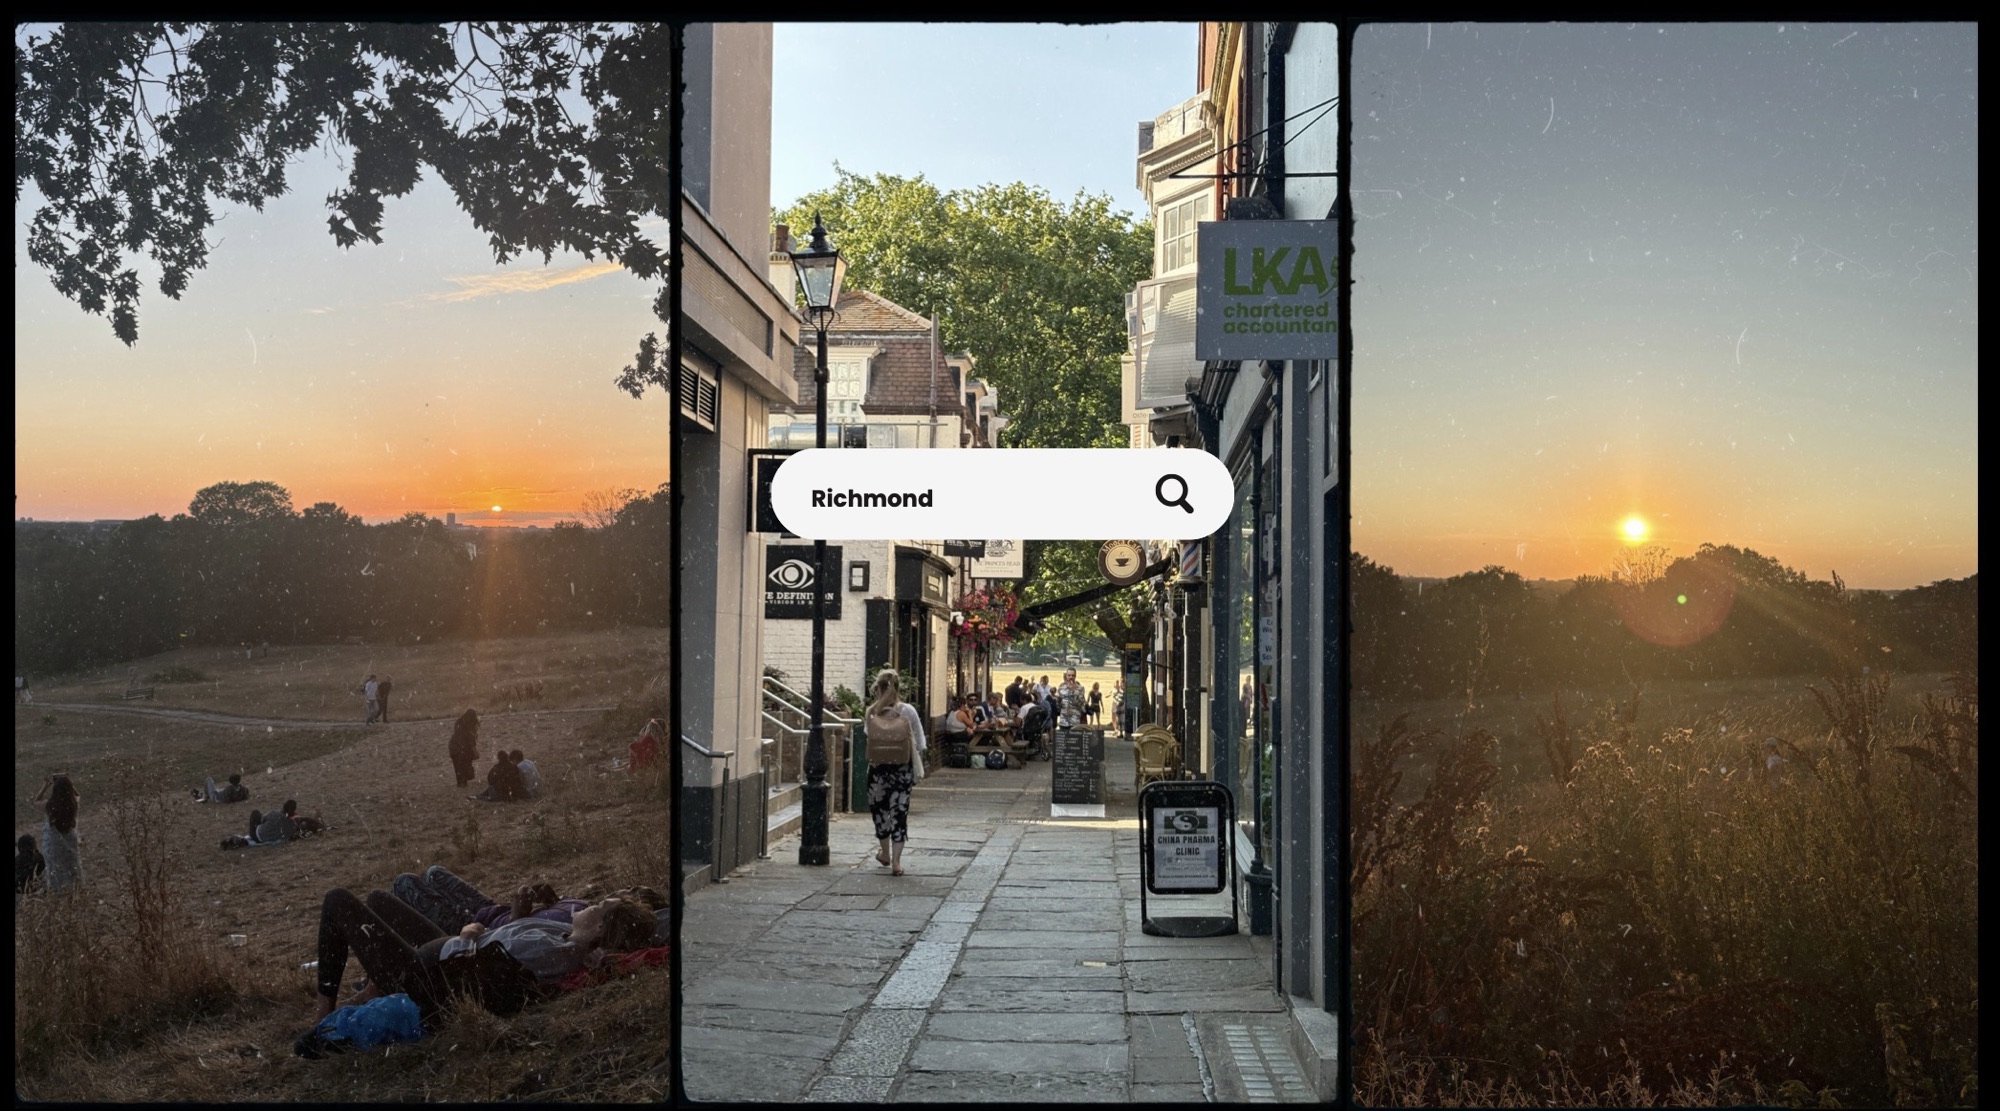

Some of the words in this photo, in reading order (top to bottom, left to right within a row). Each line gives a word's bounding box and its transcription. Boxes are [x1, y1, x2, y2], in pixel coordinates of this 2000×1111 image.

[1223, 246, 1329, 296] LKA
[1223, 301, 1329, 318] chartered
[1157, 835, 1181, 844] CHINA
[1182, 835, 1216, 844] PHARMA
[1175, 847, 1200, 856] CLINIC
